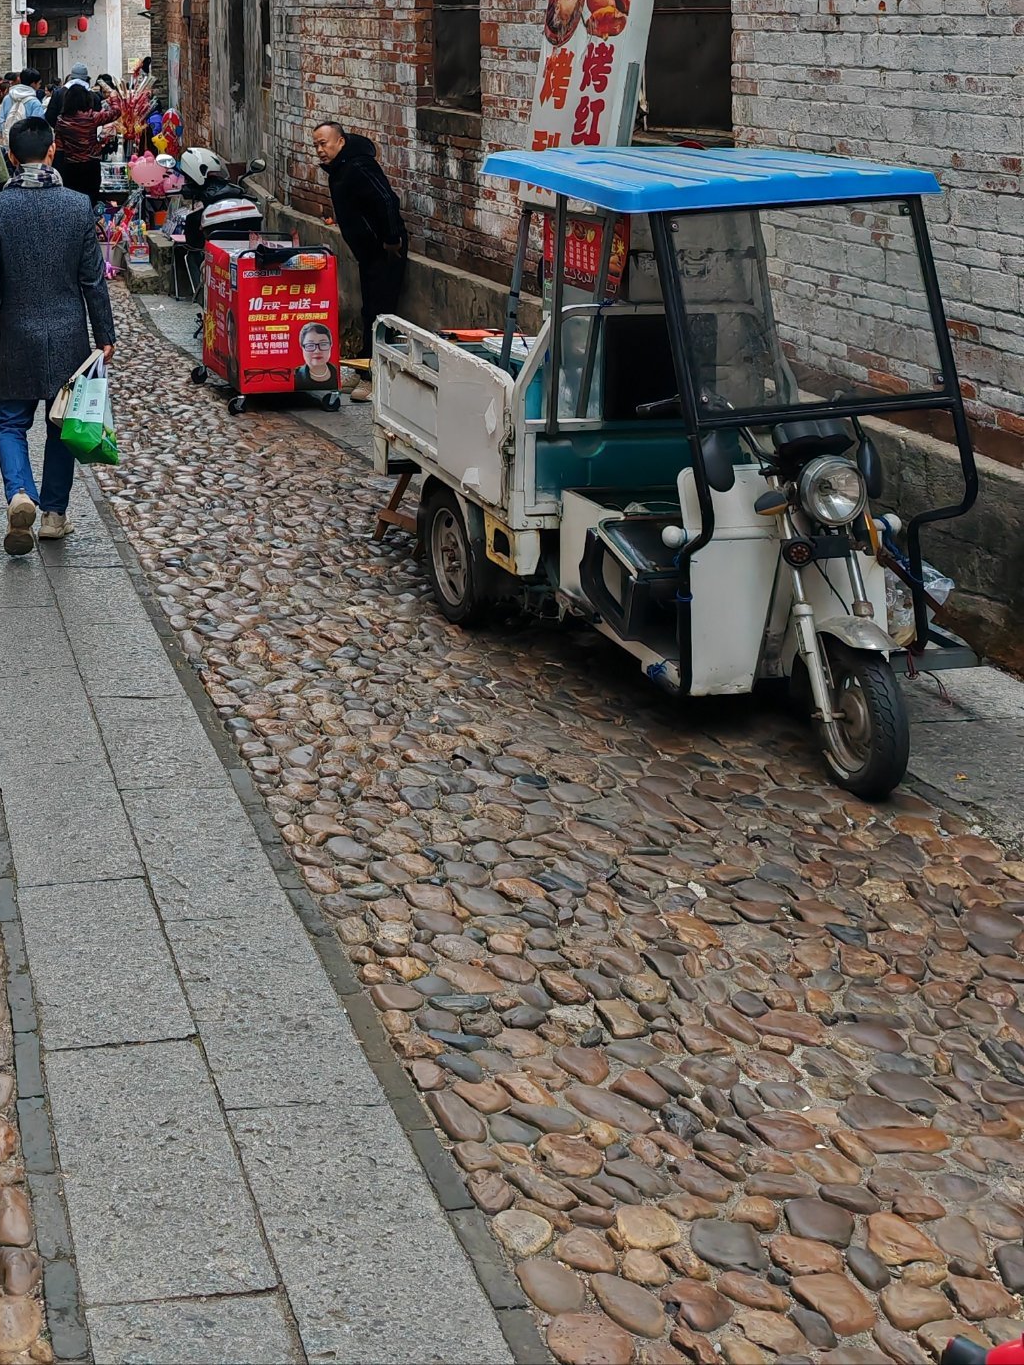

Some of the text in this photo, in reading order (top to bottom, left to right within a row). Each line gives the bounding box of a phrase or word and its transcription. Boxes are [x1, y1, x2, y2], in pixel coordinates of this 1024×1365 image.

[571, 42, 615, 146] 烤红
[261, 284, 316, 295] 自产自销
